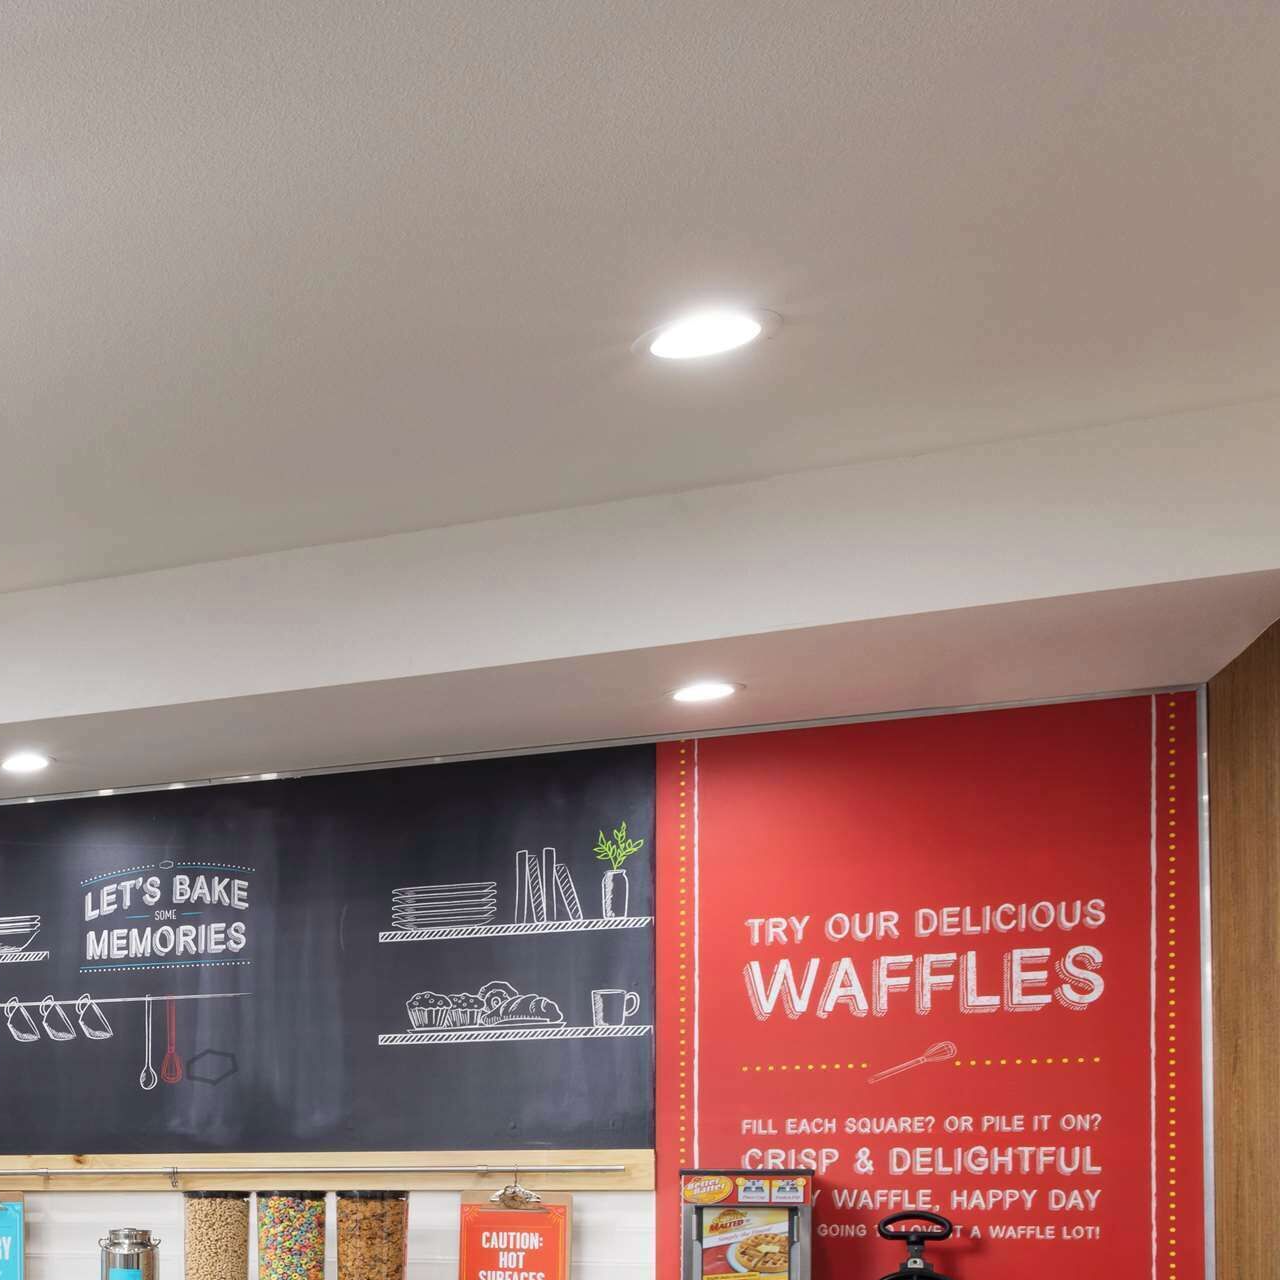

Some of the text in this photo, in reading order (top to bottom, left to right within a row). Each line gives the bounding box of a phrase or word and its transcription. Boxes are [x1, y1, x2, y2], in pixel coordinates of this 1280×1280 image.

[85, 874, 249, 921] LET'S BAKE
[154, 909, 177, 921] SOME
[745, 898, 1106, 946] TRY OUR DELICIOUS
[86, 922, 246, 960] MEMORIES
[743, 945, 1105, 1022] WAFFLES
[741, 1113, 1102, 1135] FILL EACH SQUARE? OR PILE IT ON?
[741, 1145, 1102, 1176] CRISP & DELIGHTFUL
[832, 1189, 940, 1212] WAFFLE,
[950, 1189, 1037, 1211] HAPPY
[1048, 1189, 1102, 1211] DAY
[481, 1231, 544, 1249] CAUTION:
[817, 1224, 867, 1238] GOING
[970, 1226, 981, 1239] A
[988, 1225, 1055, 1239] WAFFLE
[1062, 1225, 1101, 1239] LOT!
[498, 1251, 526, 1269] HOT
